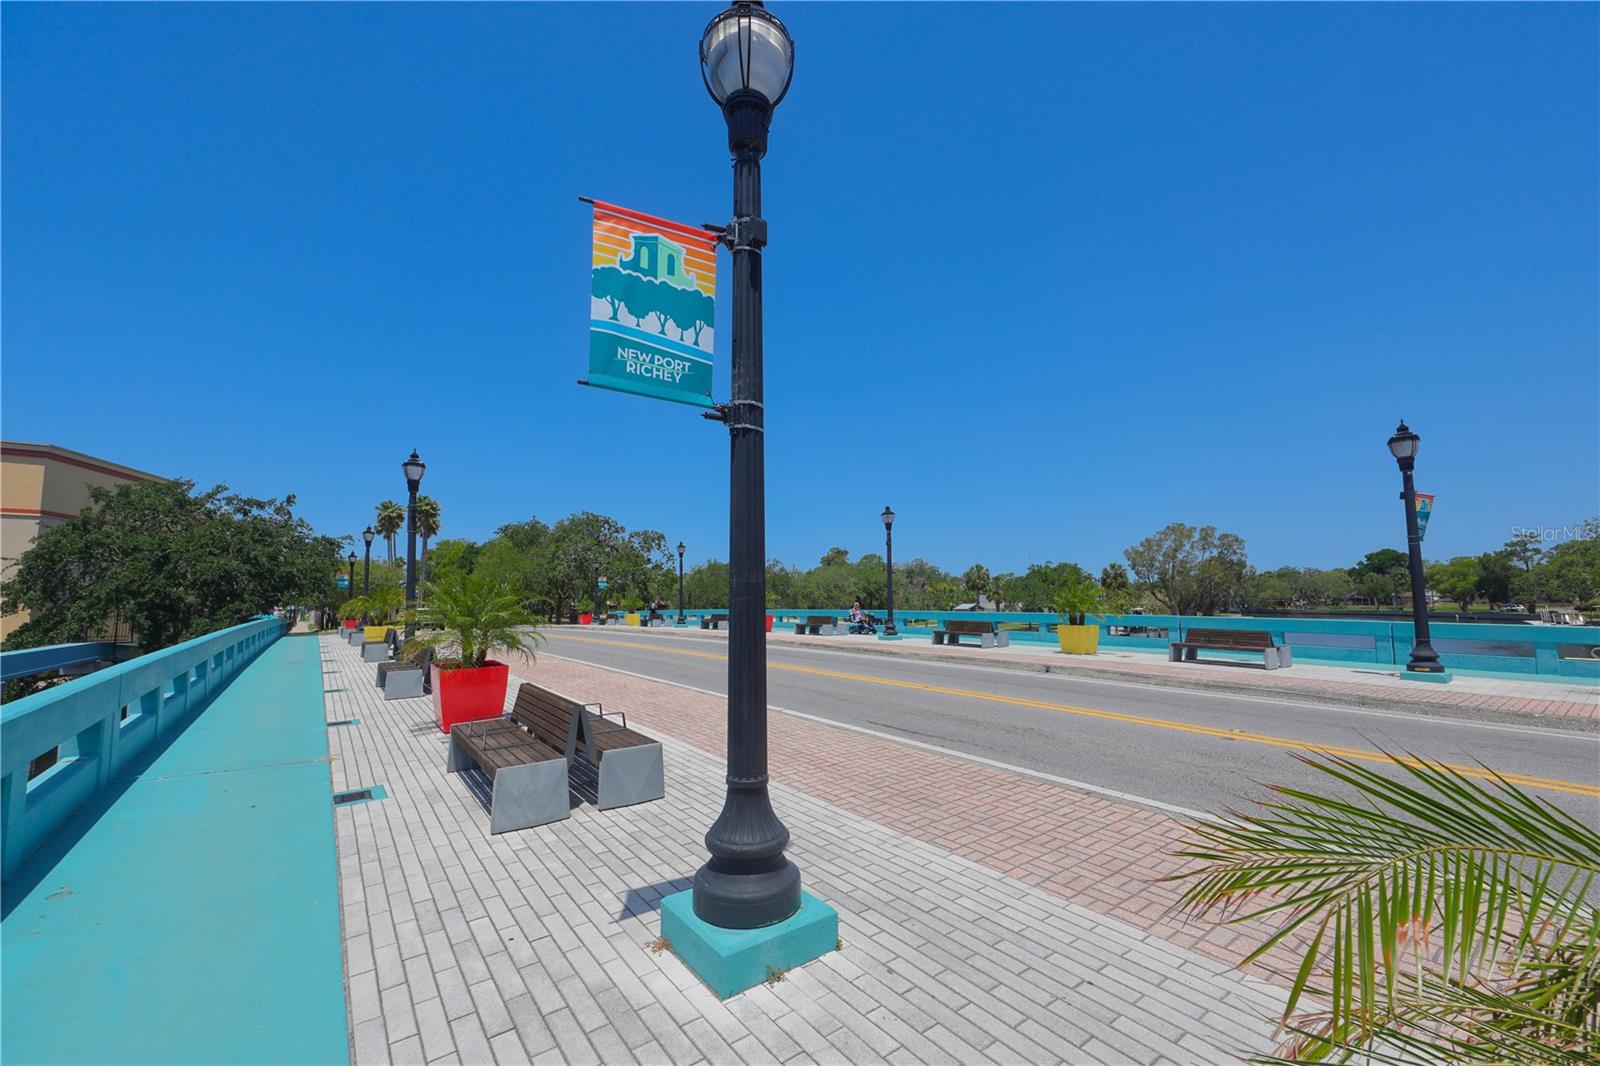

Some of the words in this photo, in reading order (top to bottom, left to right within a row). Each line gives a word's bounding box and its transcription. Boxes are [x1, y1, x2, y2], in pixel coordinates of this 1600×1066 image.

[617, 346, 652, 362] NEW
[654, 355, 691, 372] PORT
[626, 361, 682, 383] RICHEY
